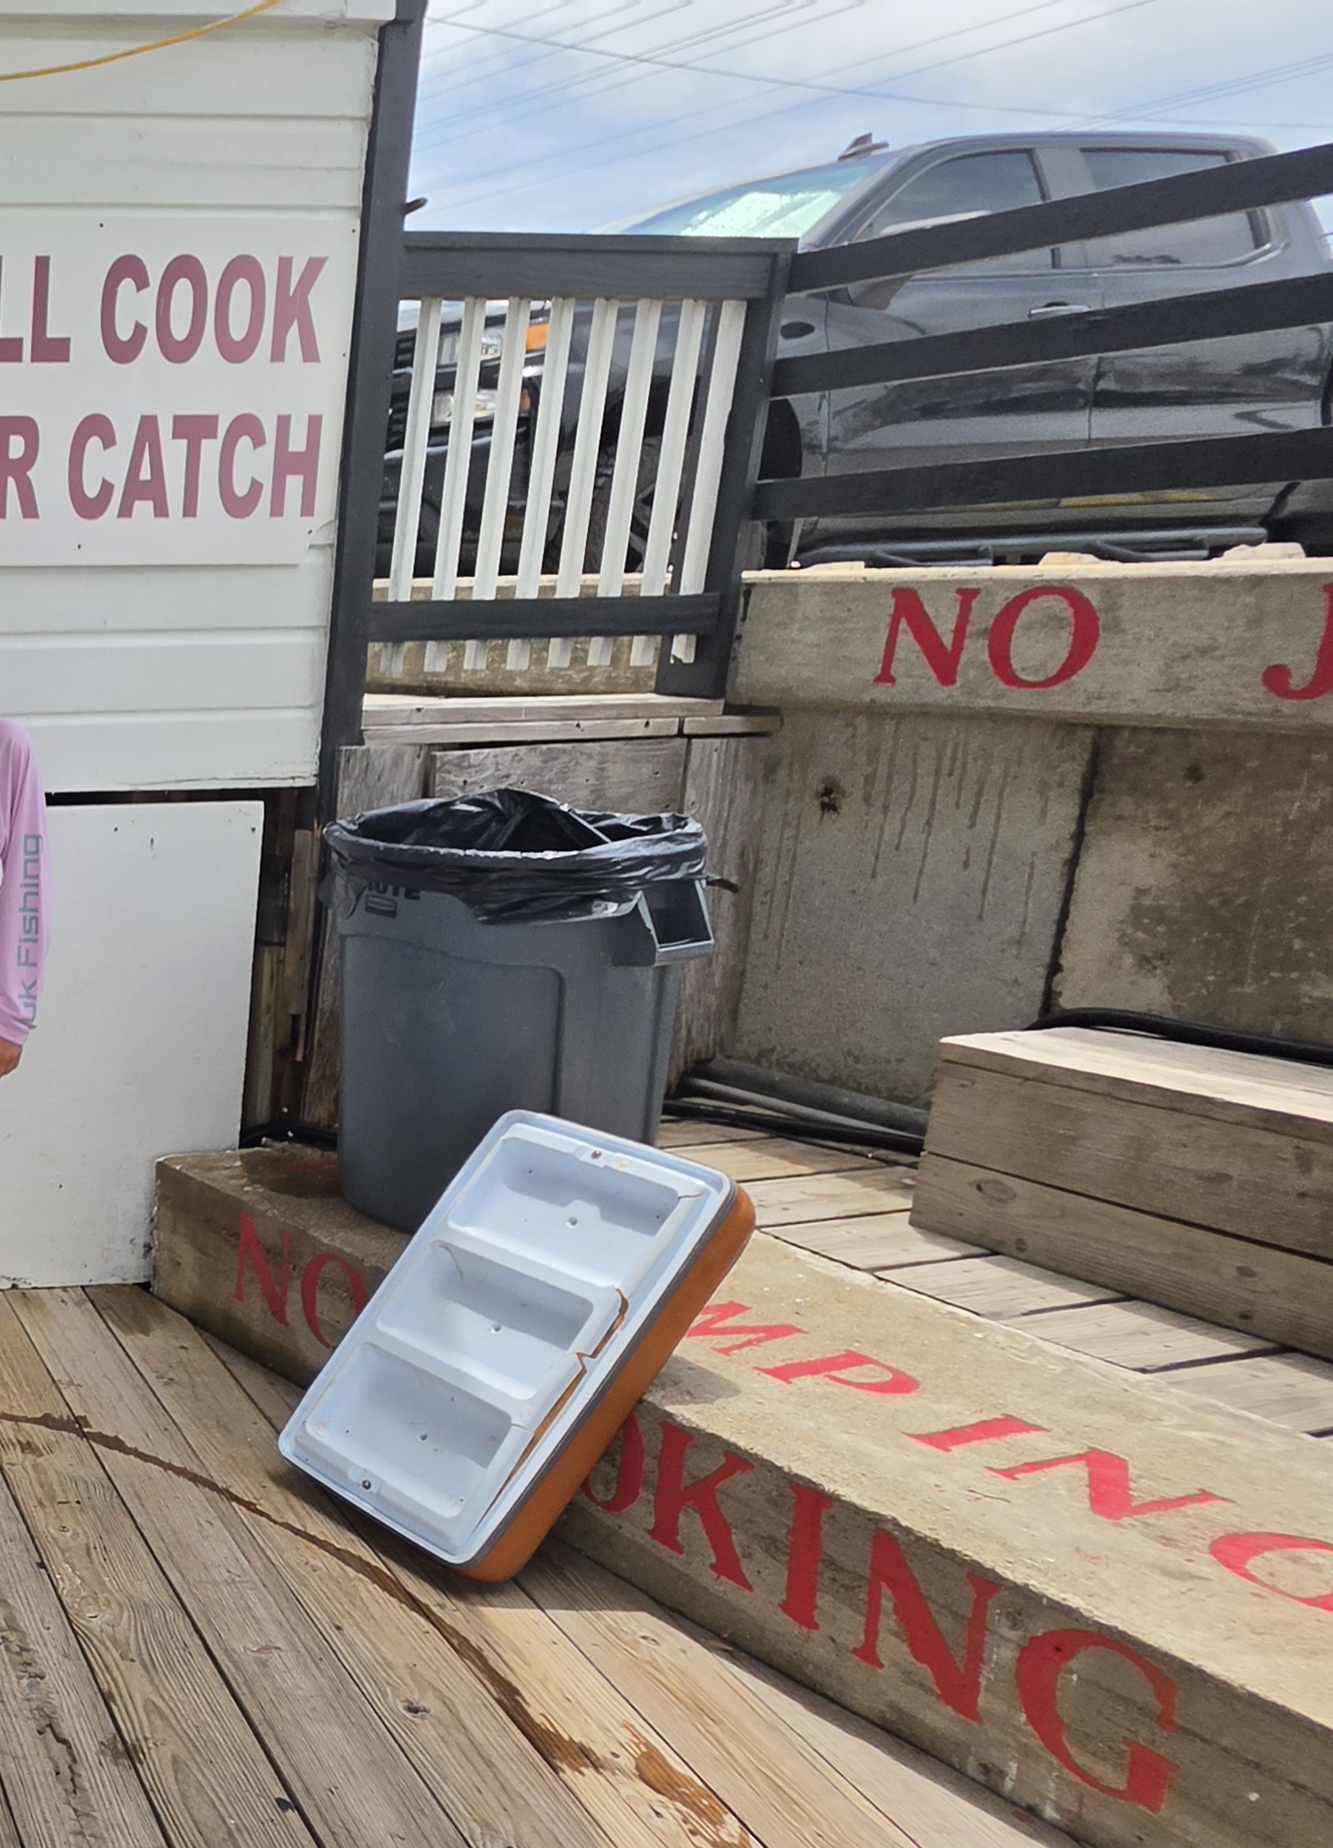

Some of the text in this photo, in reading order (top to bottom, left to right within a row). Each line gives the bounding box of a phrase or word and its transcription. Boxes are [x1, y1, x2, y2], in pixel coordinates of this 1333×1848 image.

[100, 253, 329, 364] COOK
[67, 413, 324, 522] CATCH
[874, 586, 1101, 690] NO
[16, 834, 43, 1025] uk Fishing
[234, 1211, 369, 1351] NO
